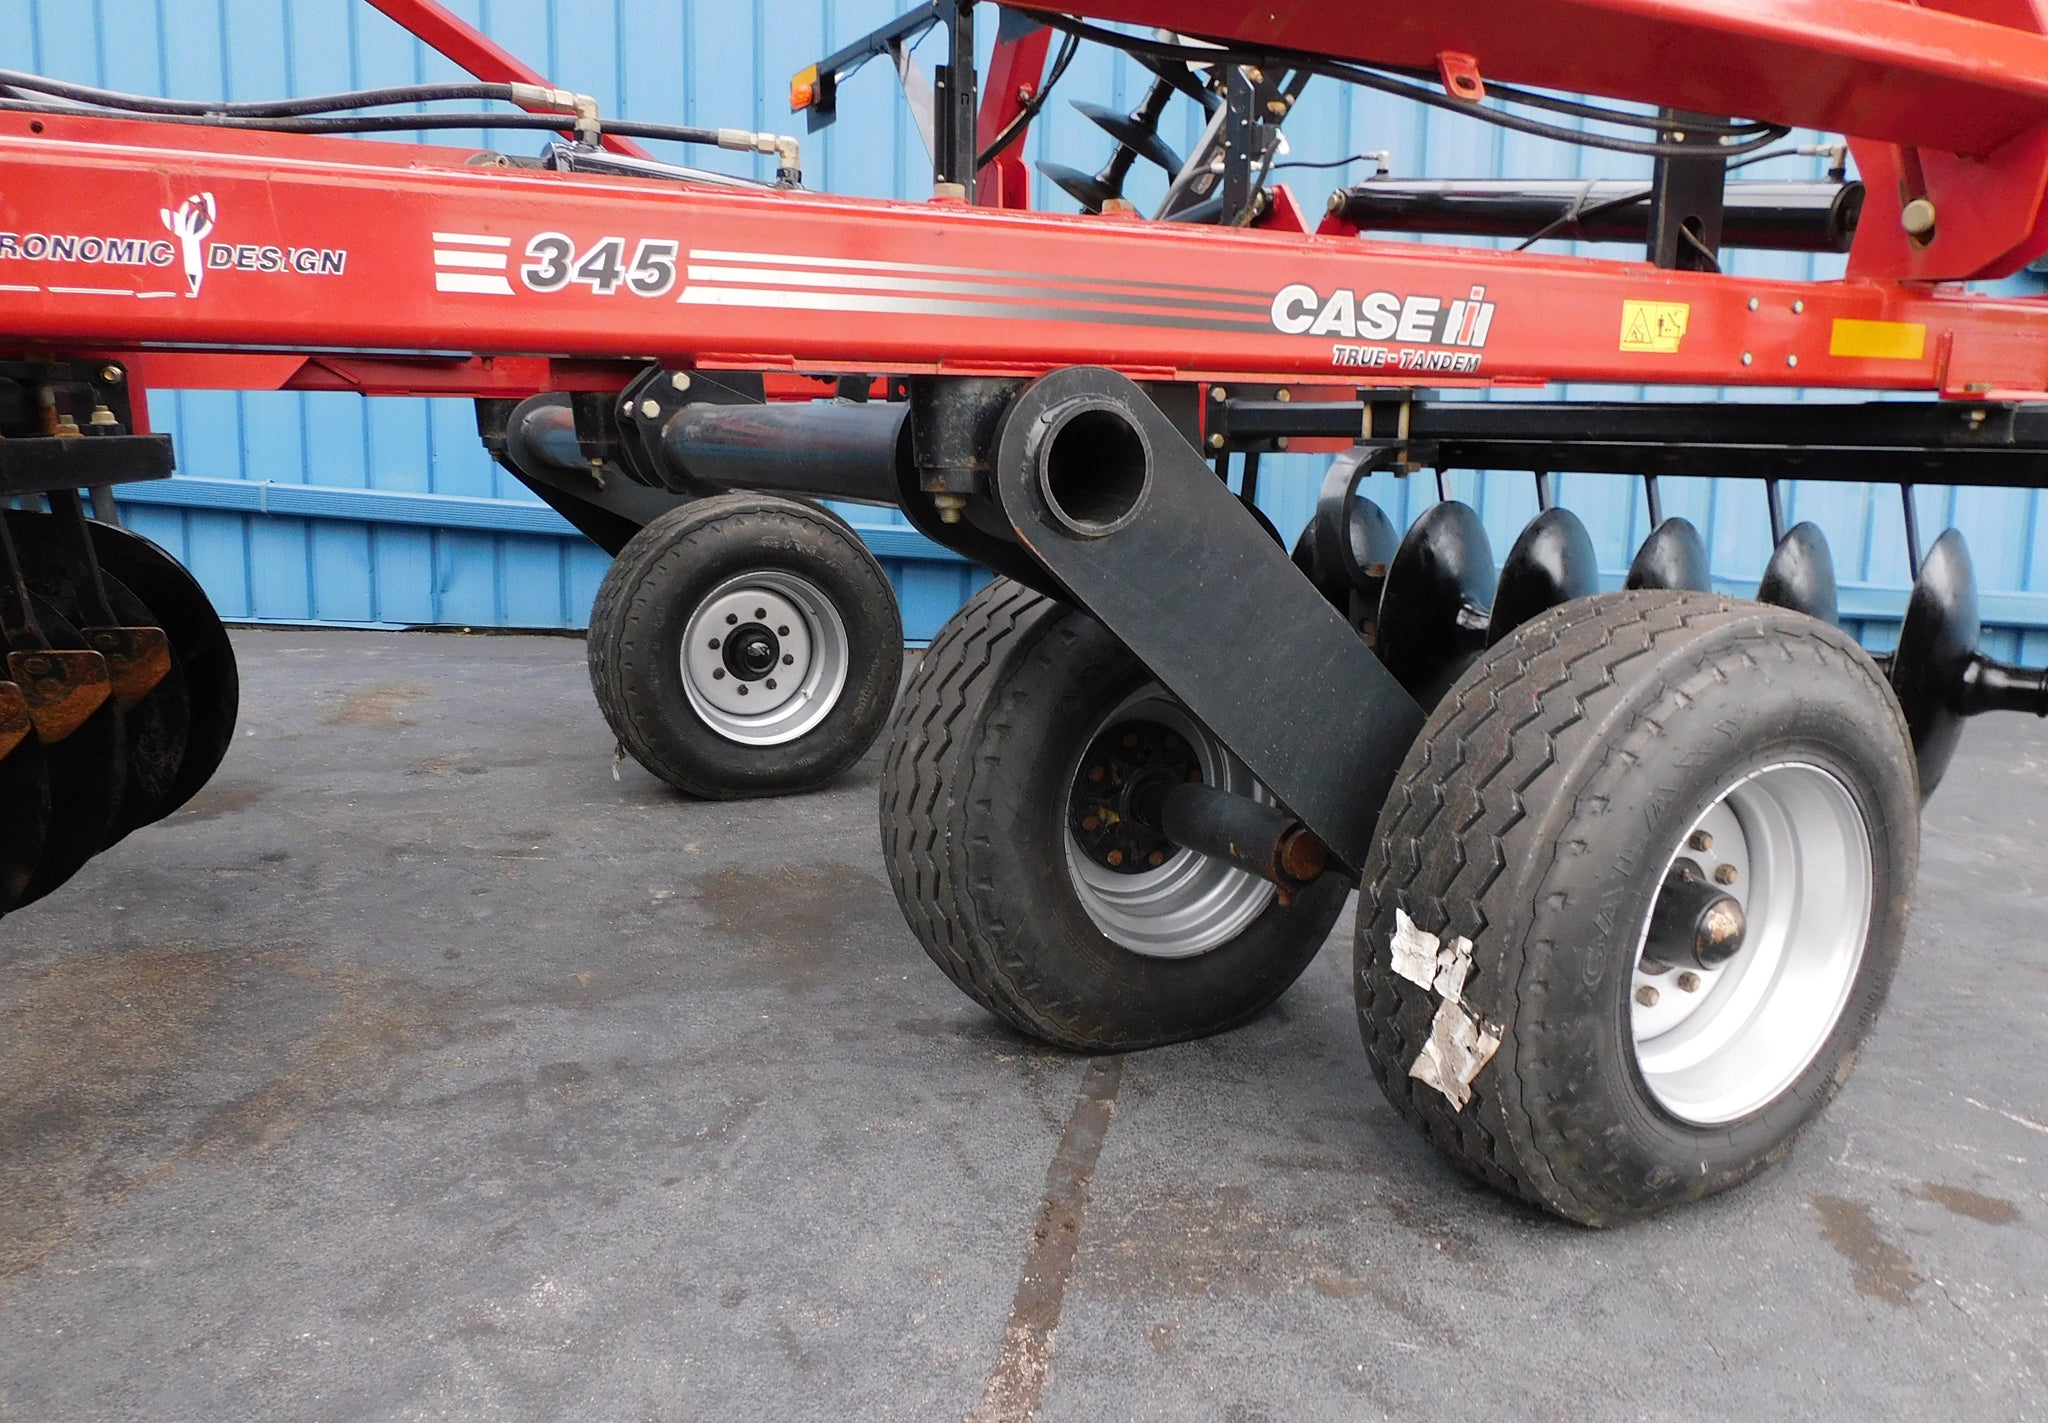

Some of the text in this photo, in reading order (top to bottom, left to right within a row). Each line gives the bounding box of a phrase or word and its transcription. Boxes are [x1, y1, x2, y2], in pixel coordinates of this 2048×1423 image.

[0, 231, 346, 275] RONOMIC DESIGN
[521, 232, 679, 297] 345
[1271, 284, 1440, 343] CASE
[1332, 344, 1482, 372] TRUE-TANDEM
